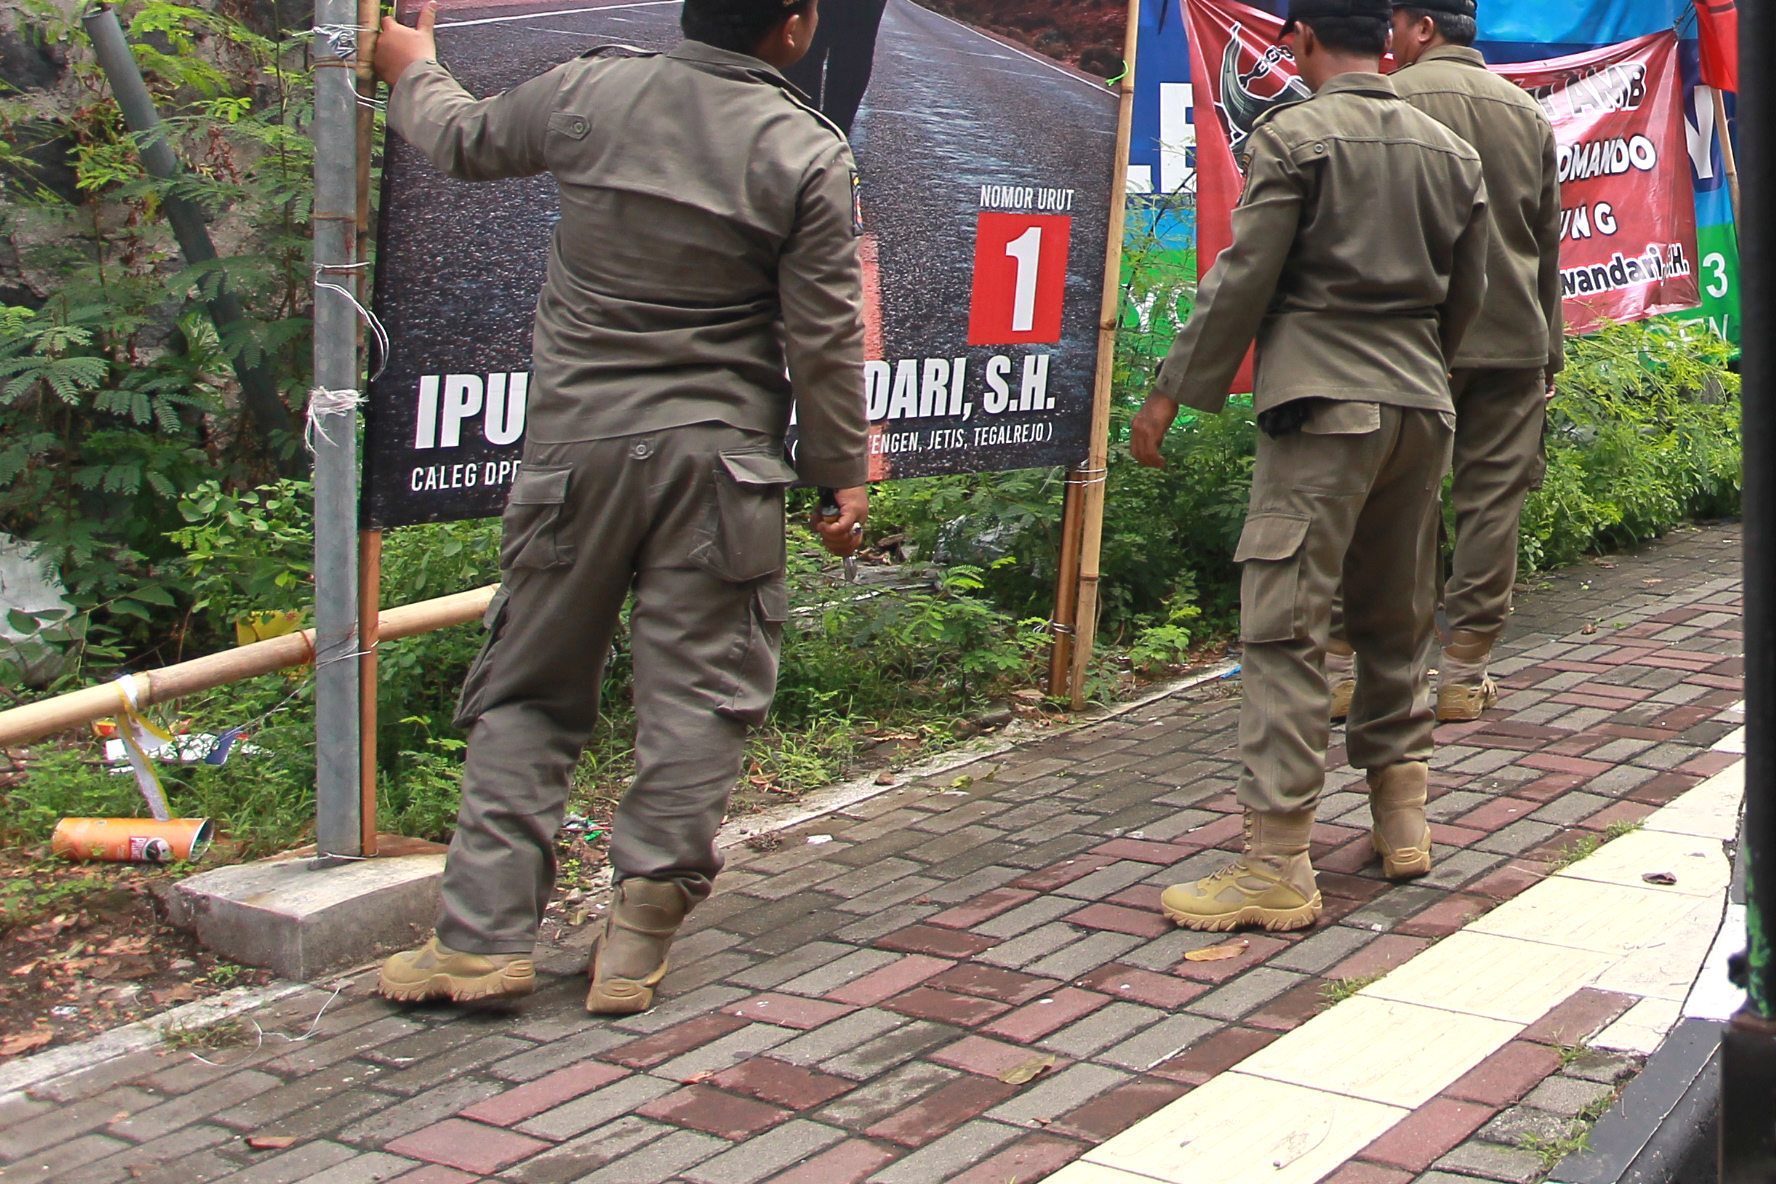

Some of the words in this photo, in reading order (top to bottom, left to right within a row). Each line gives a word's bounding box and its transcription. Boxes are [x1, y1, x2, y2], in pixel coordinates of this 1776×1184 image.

[1556, 133, 1658, 184] OMANDO
[980, 184, 1033, 209] NOMOR
[1037, 188, 1075, 211] URUT
[1005, 226, 1043, 332] 1
[1702, 252, 1729, 298] 3
[414, 371, 529, 450] IPU
[863, 356, 974, 422] DARI,
[983, 354, 1056, 415] S.H.
[411, 462, 478, 492] CALEG
[868, 432, 923, 456] ENGEN,
[926, 427, 968, 452] JETIS,
